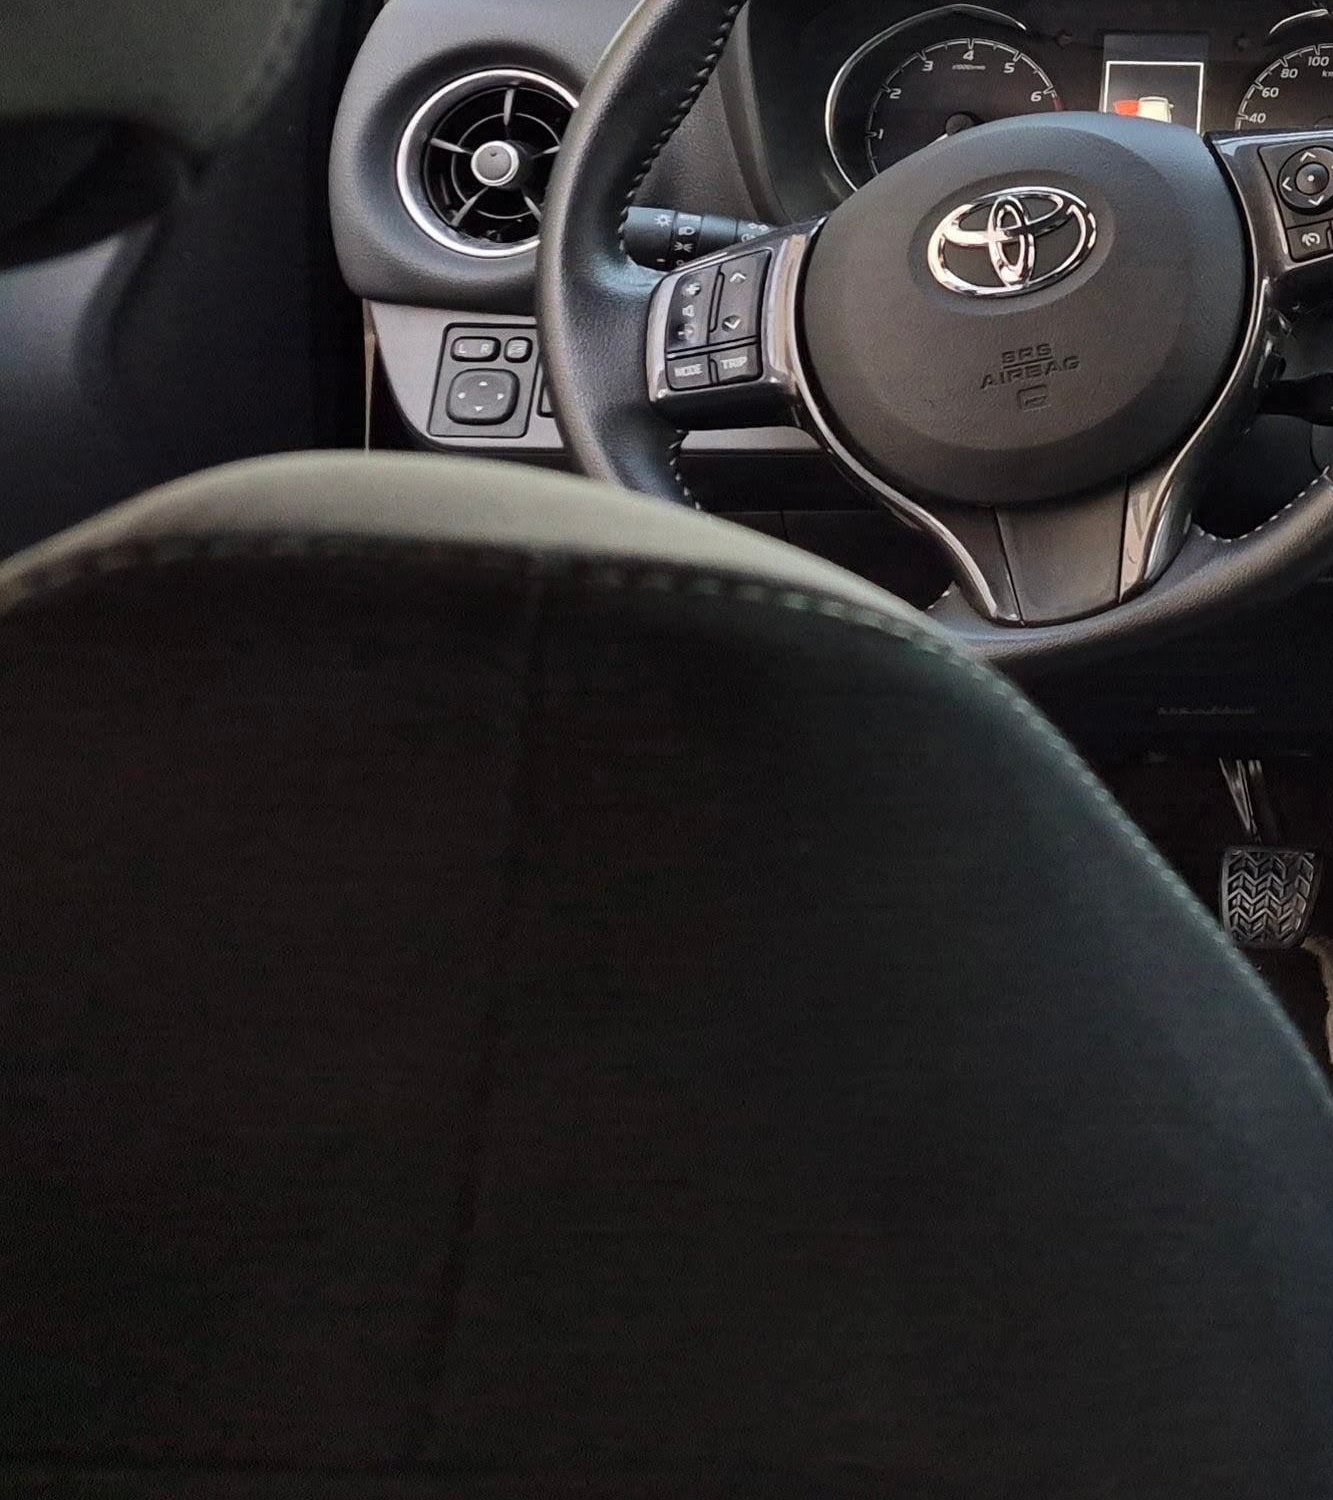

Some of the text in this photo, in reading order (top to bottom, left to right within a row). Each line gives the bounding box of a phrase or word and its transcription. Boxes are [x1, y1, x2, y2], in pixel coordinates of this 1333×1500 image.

[963, 49, 974, 61] 4
[922, 61, 934, 72] 3
[1308, 56, 1330, 67] 100
[1003, 62, 1015, 73] 5
[1280, 68, 1298, 79] 80
[889, 88, 902, 99] 2
[1030, 91, 1042, 102] 6
[1261, 87, 1279, 98] 60
[1249, 113, 1267, 124] 40
[876, 128, 885, 140] 1
[458, 343, 490, 354] L R
[1001, 343, 1052, 364] SRS
[721, 355, 749, 370] TRIP
[674, 363, 704, 378] MODE
[981, 355, 1080, 389] AIRBAG
